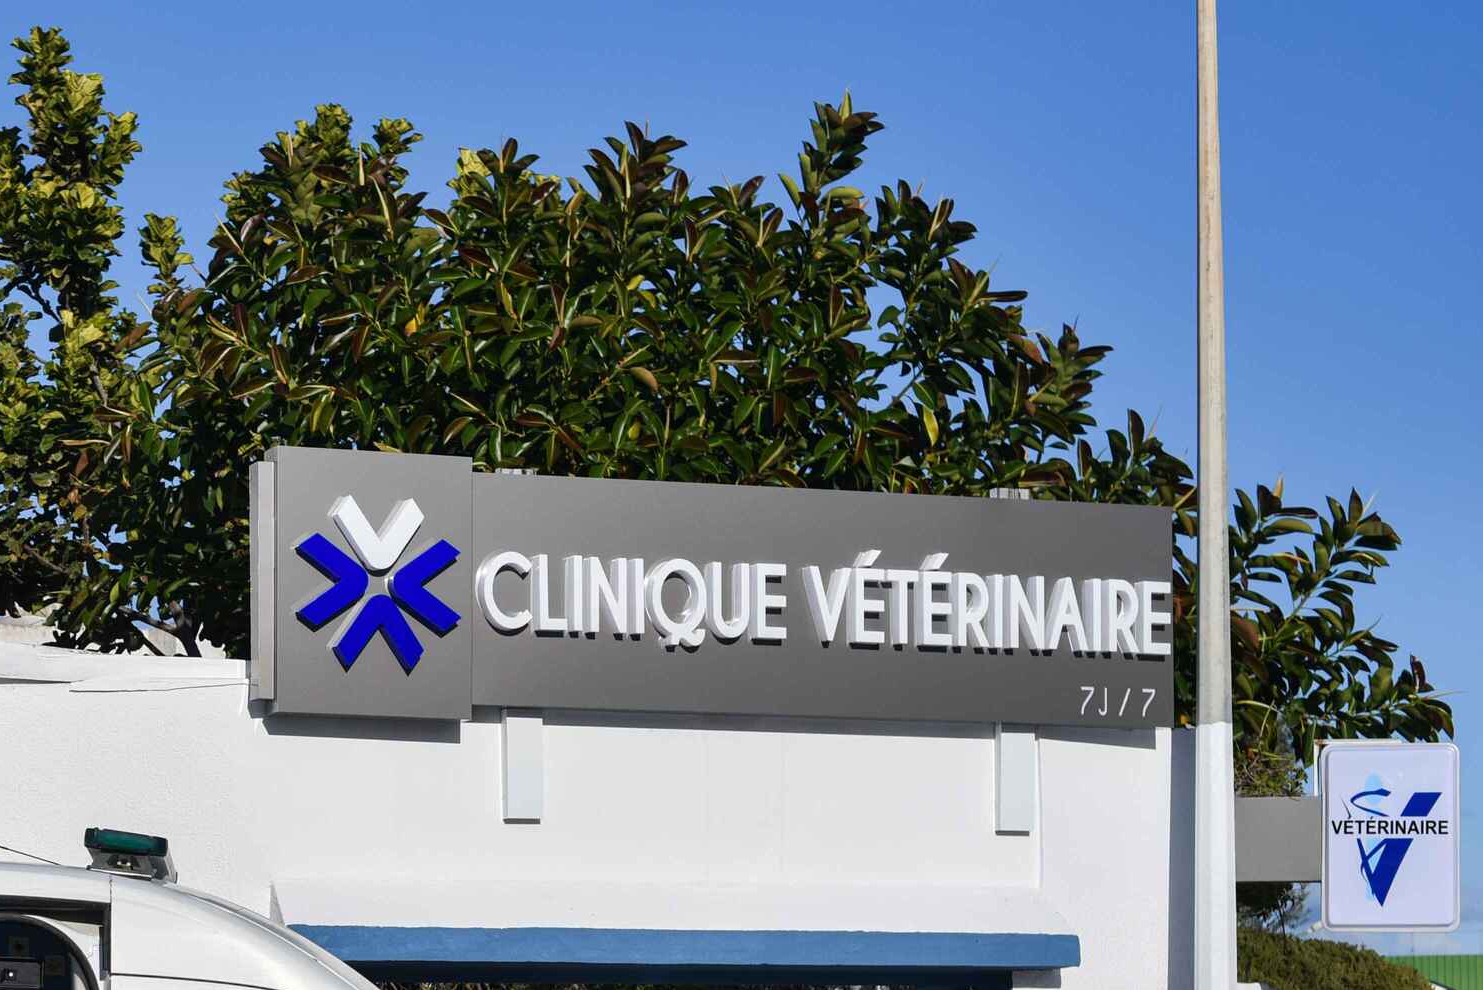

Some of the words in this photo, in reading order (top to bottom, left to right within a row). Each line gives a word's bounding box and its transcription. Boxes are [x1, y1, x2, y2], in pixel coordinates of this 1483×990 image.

[475, 551, 787, 647] CLINIQUE
[801, 549, 1172, 656] VÉTÉRINAIRE
[1331, 816, 1449, 835] VÉTÉRINAIRE
